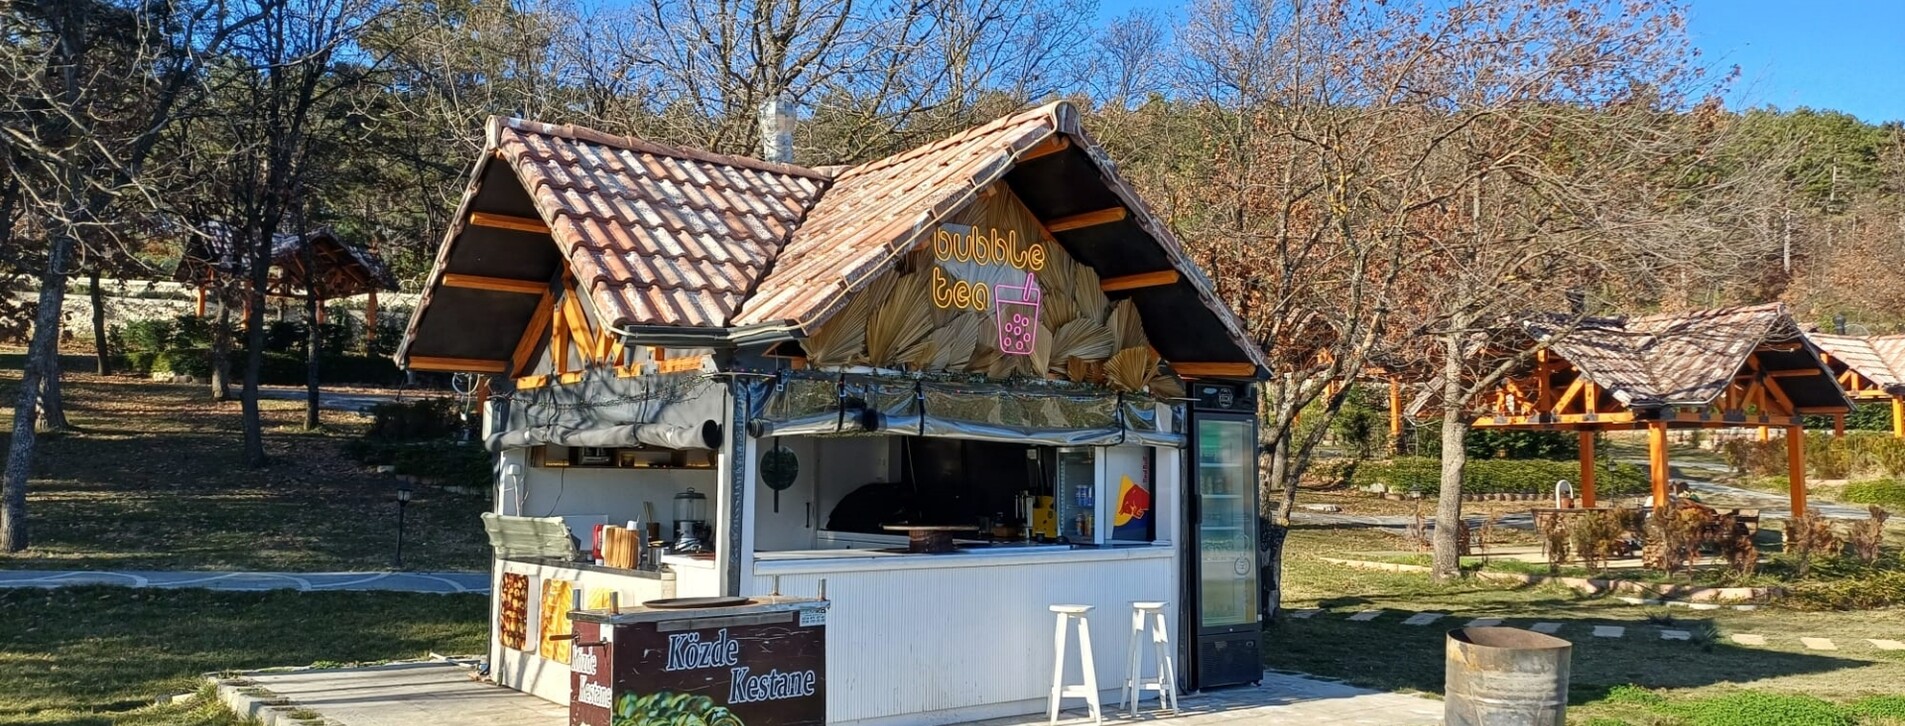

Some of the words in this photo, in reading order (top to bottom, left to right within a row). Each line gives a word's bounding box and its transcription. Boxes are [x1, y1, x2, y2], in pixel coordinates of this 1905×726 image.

[934, 225, 1045, 271] bubble
[933, 266, 990, 311] tea
[571, 644, 597, 675] Közde
[666, 628, 738, 671] Közde
[578, 675, 611, 708] Kestane
[728, 666, 815, 704] Kestane
